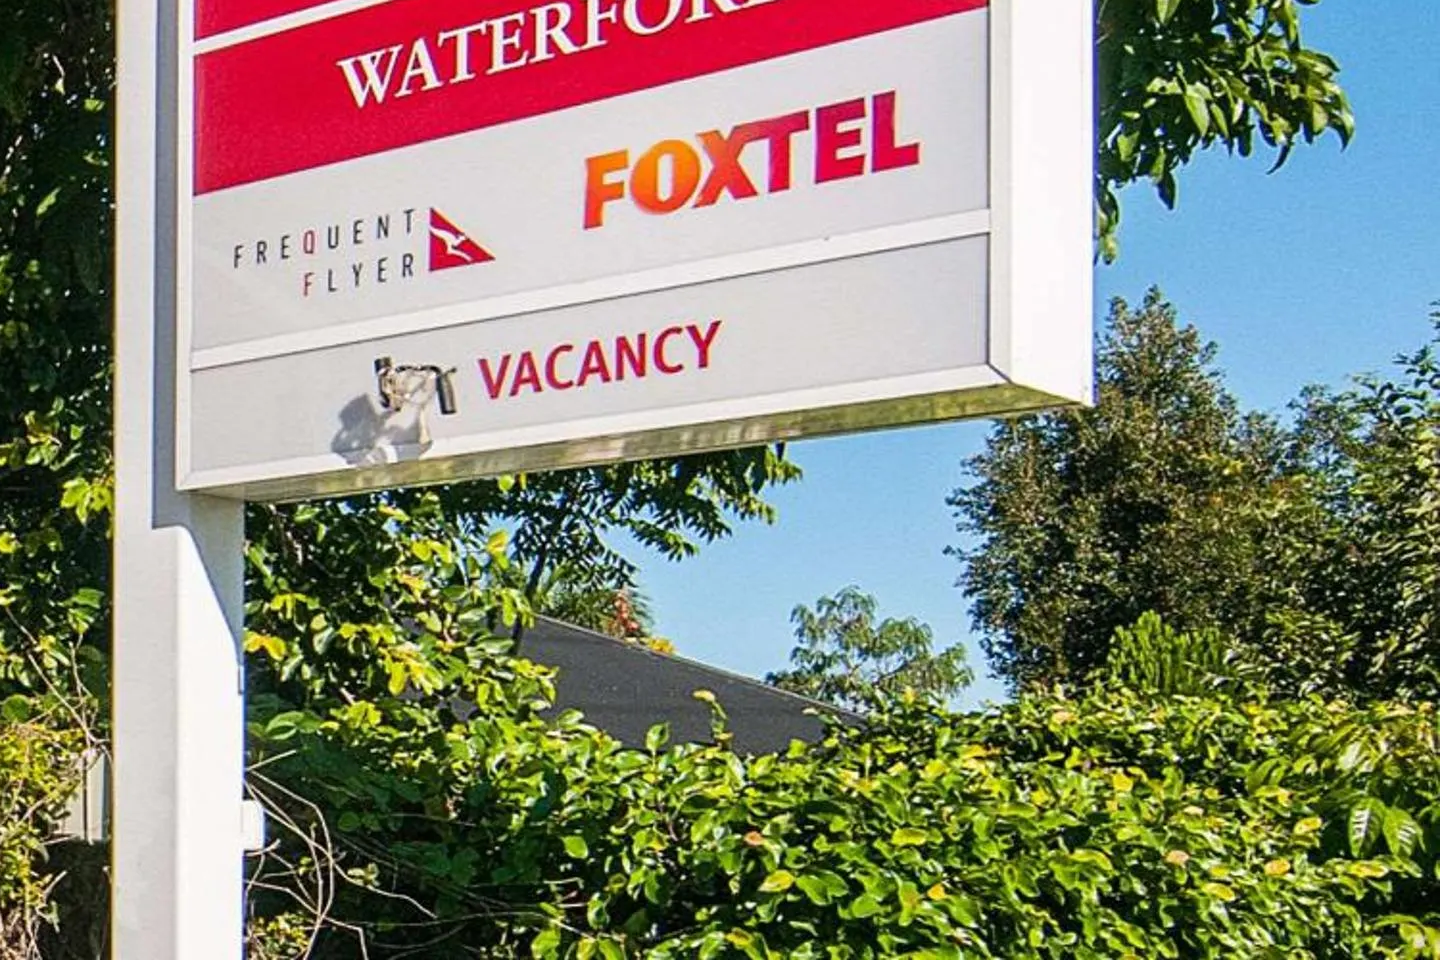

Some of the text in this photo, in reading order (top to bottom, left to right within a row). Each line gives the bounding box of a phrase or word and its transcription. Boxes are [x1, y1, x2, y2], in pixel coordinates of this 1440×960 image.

[583, 90, 921, 231] FOXTEL
[232, 208, 417, 270] FREQUENT
[303, 252, 416, 299] FLYER
[477, 320, 722, 401] VACANCY
